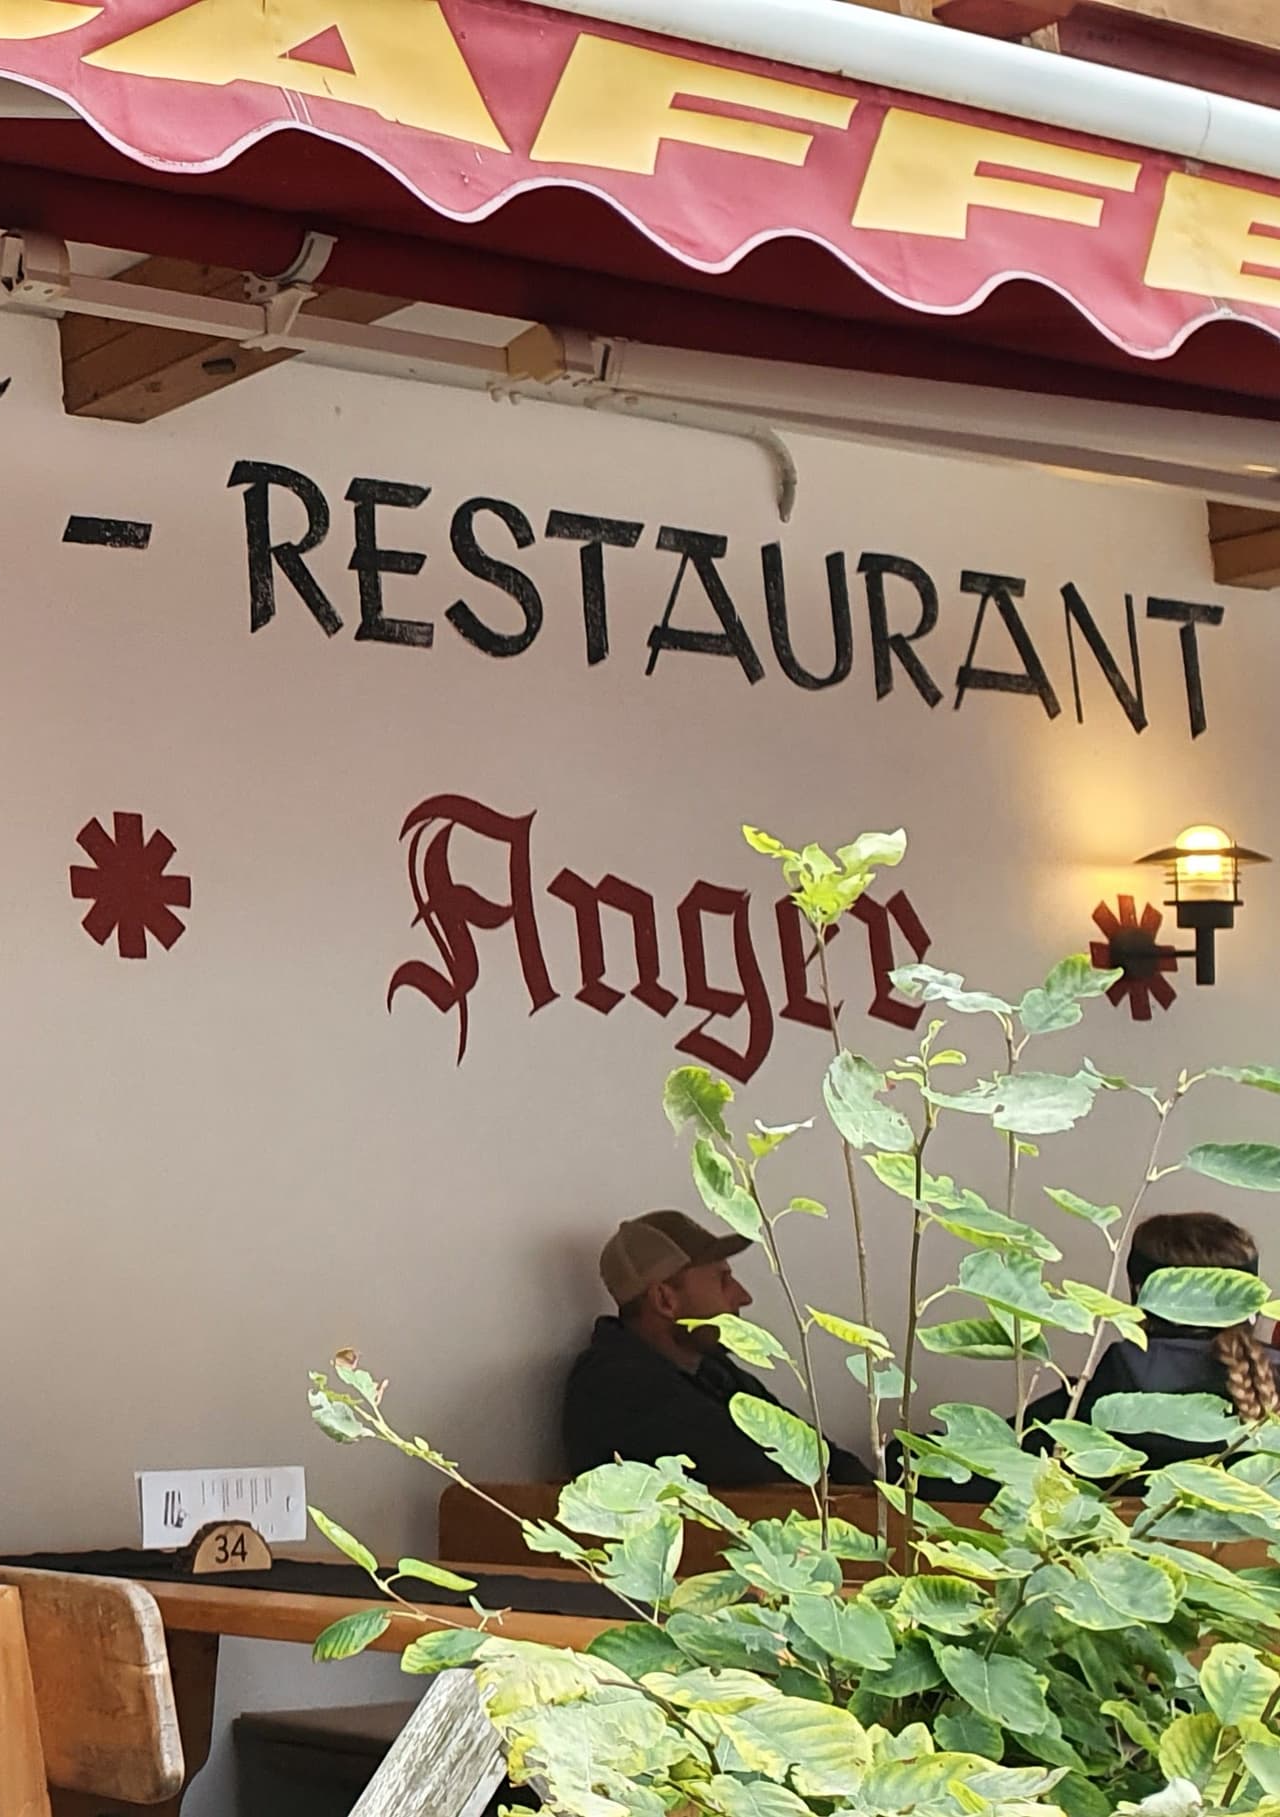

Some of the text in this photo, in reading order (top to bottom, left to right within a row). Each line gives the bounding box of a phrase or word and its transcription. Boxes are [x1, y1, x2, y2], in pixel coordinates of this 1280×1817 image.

[226, 459, 1226, 740] RESTAURANT
[386, 793, 932, 1085] Anger
[215, 1533, 248, 1565] 34
